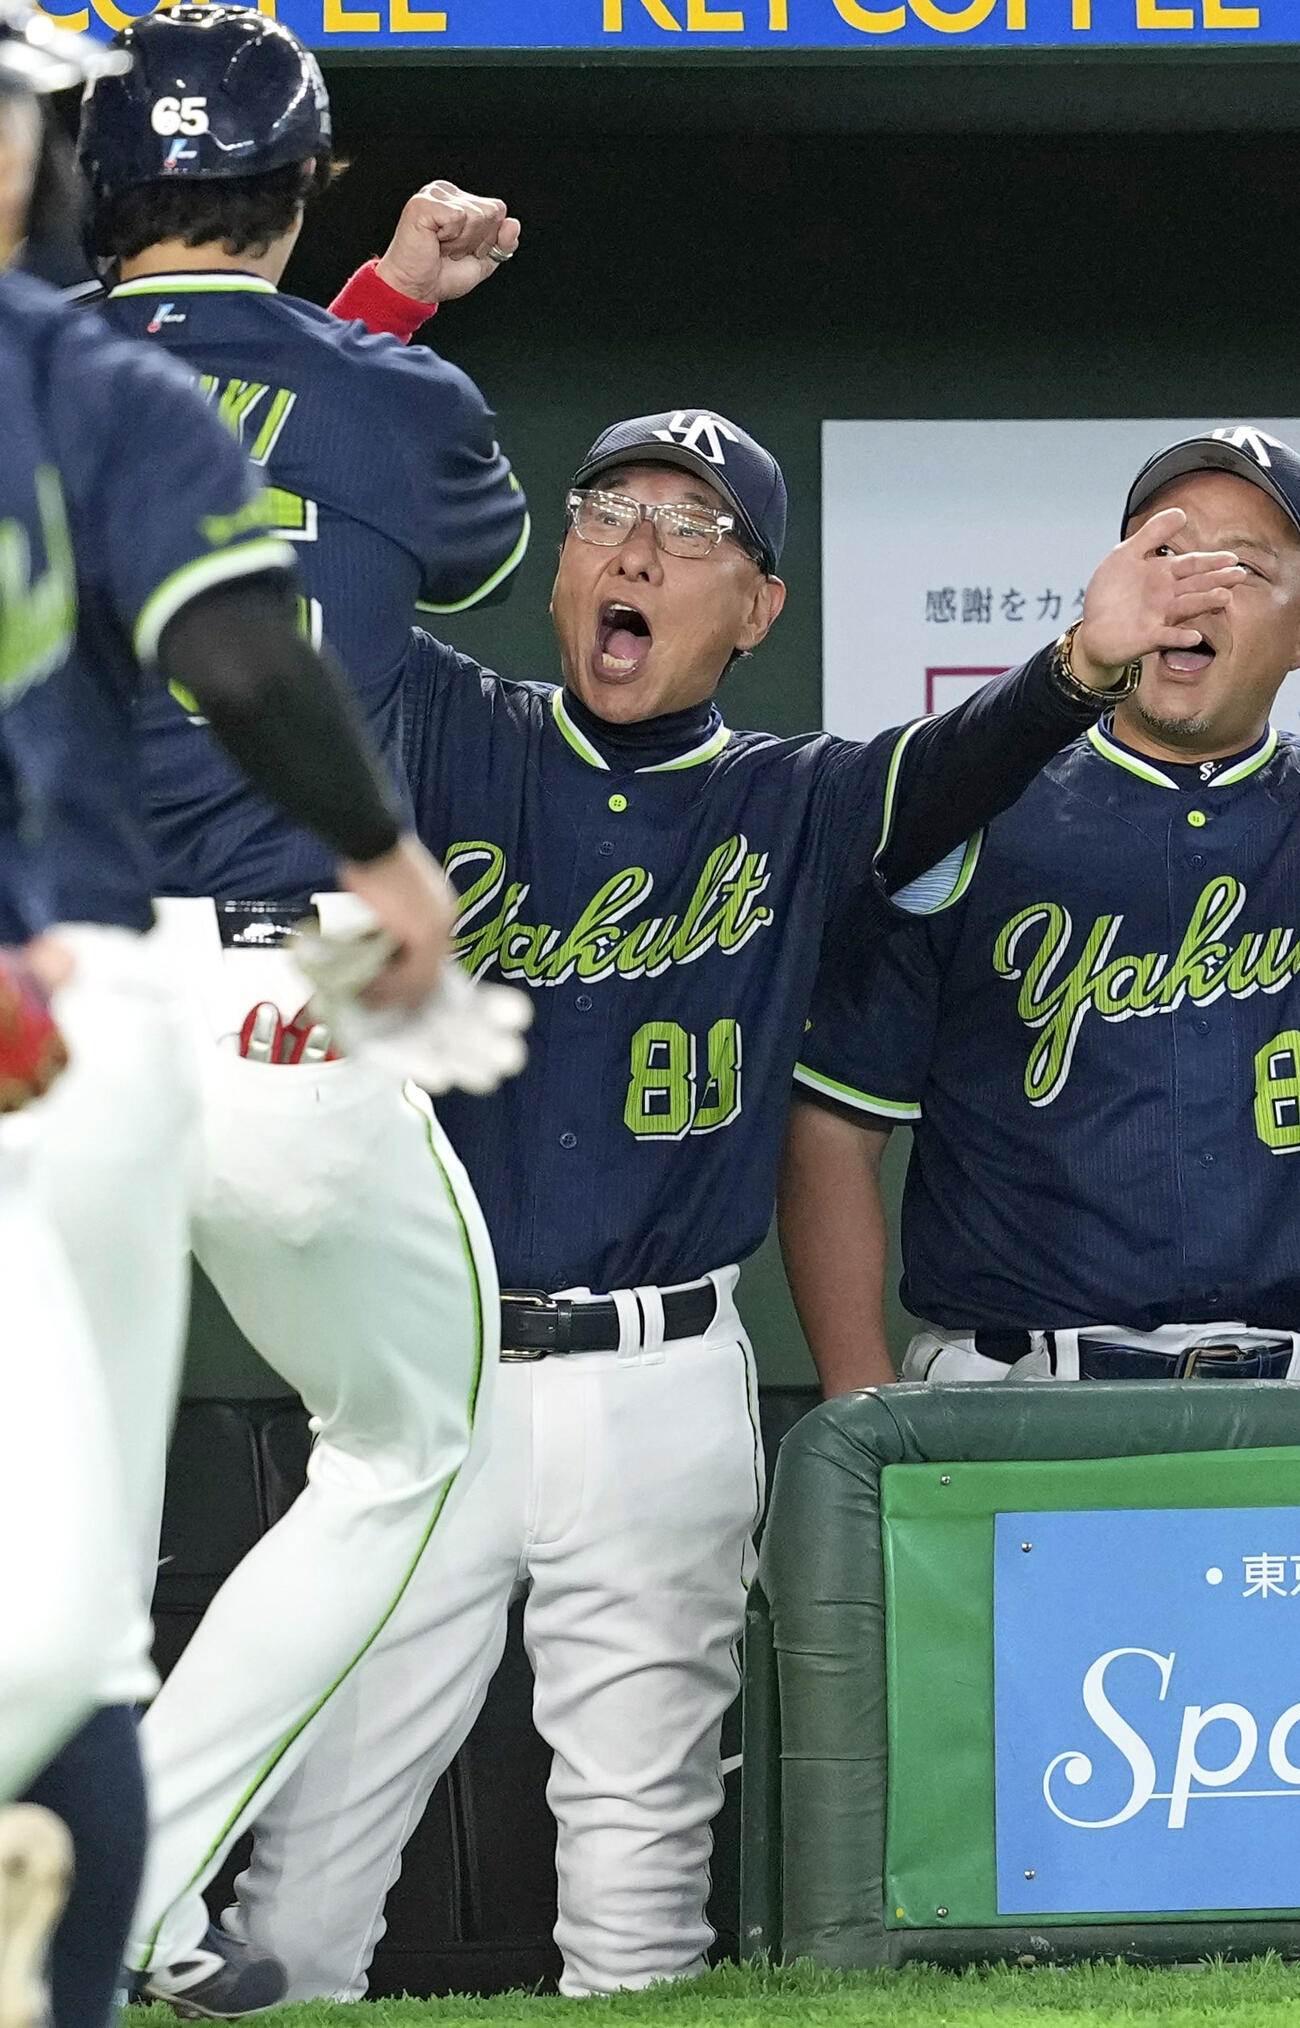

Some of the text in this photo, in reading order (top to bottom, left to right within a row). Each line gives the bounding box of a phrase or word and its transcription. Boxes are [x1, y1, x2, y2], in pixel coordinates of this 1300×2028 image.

[151, 96, 209, 136] 65
[443, 833, 774, 988] Yakult
[993, 875, 1300, 1107] Yaku
[1242, 1552, 1300, 1598] 東
